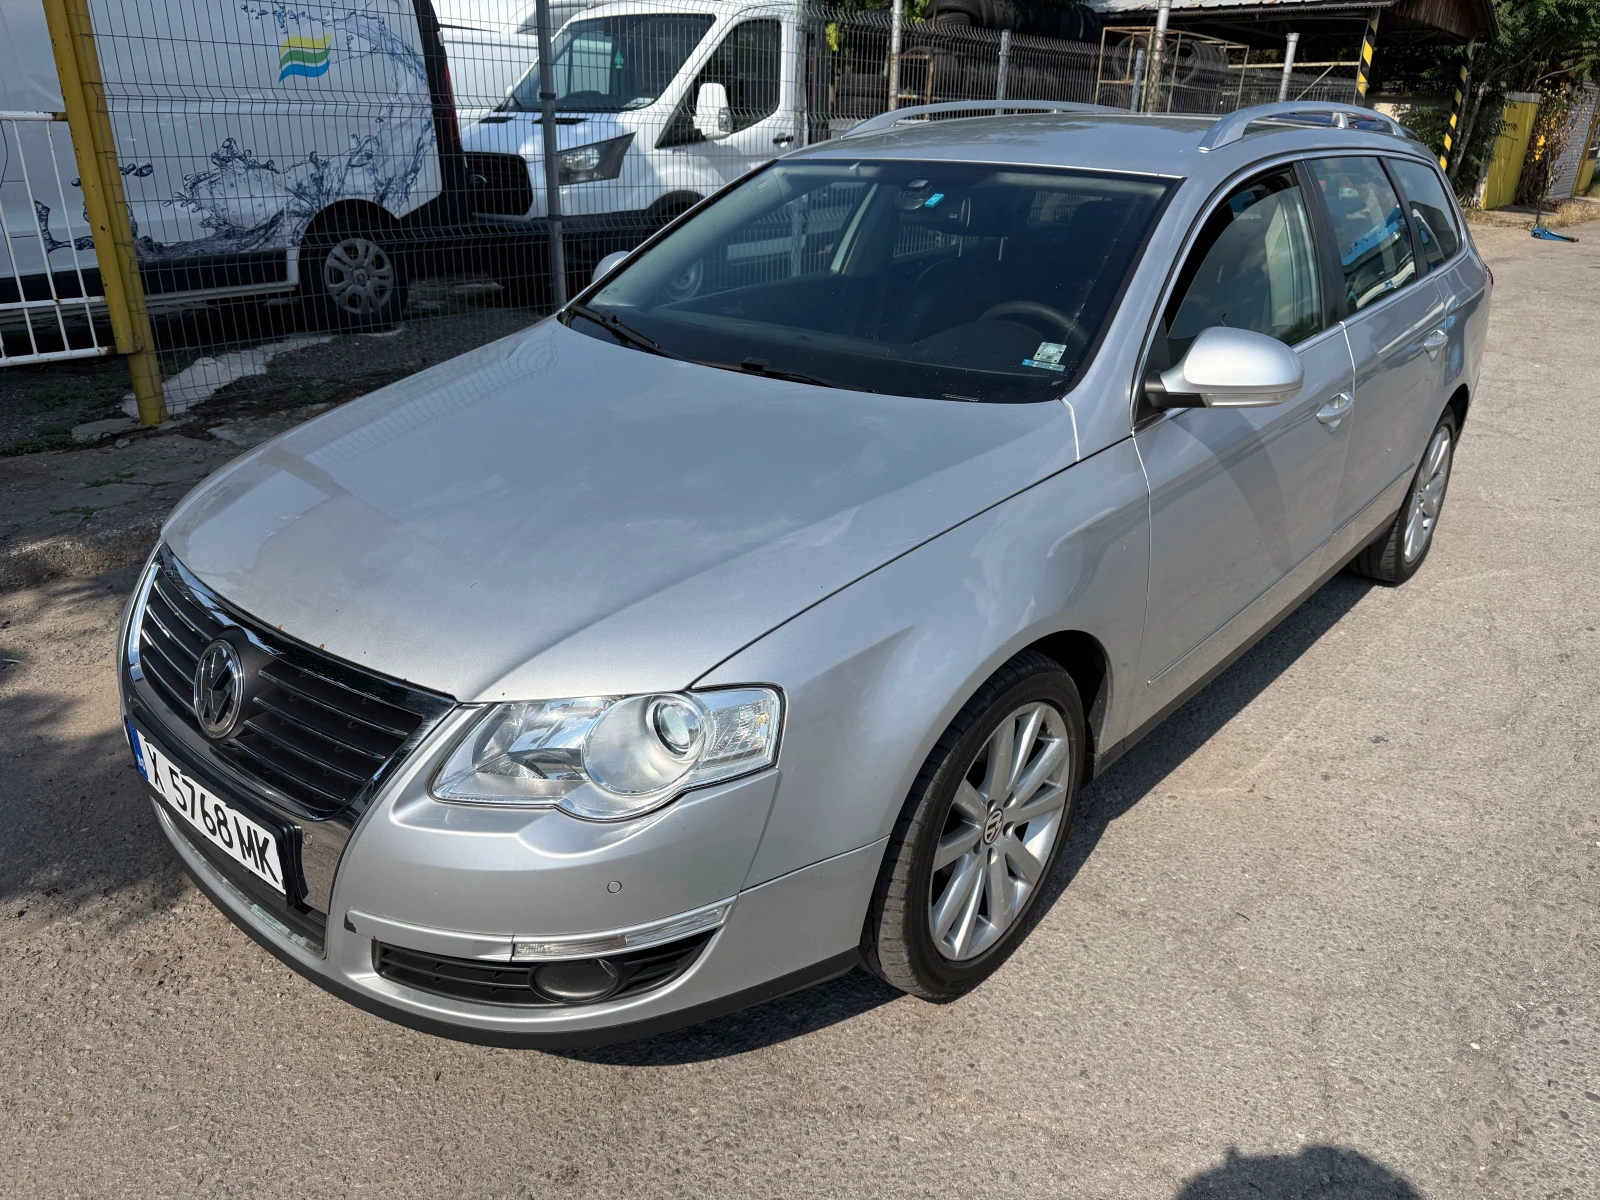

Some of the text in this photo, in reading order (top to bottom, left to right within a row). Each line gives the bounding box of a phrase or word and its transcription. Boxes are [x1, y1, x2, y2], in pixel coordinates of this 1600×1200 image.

[146, 744, 279, 884] X 5768 MK
